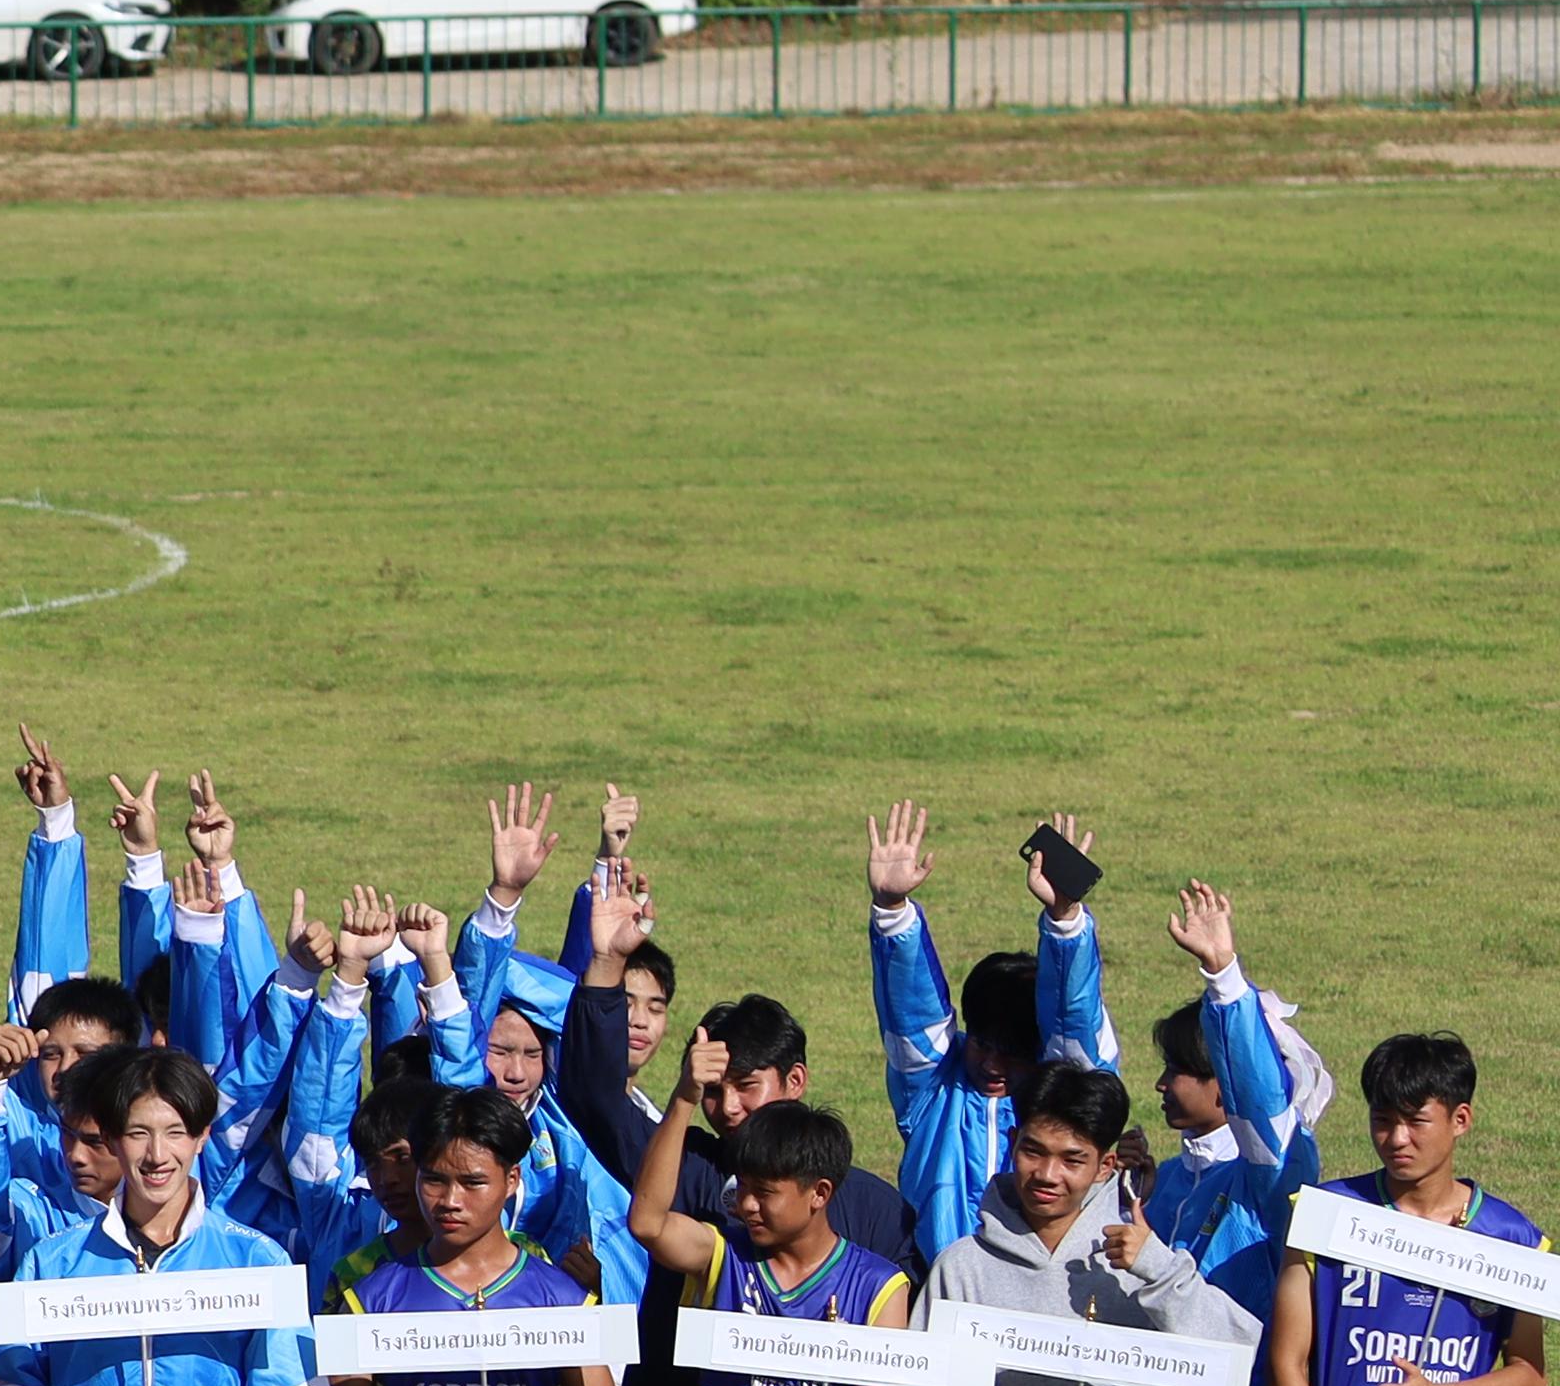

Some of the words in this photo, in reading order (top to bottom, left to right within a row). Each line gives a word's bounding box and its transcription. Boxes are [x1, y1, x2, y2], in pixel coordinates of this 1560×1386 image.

[1350, 1217, 1547, 1292] โรงเรียนสรรพวิทยาคม
[1341, 1264, 1382, 1308] 21
[728, 1327, 930, 1371] วิทยาลัยเทคนิคแม่สอด
